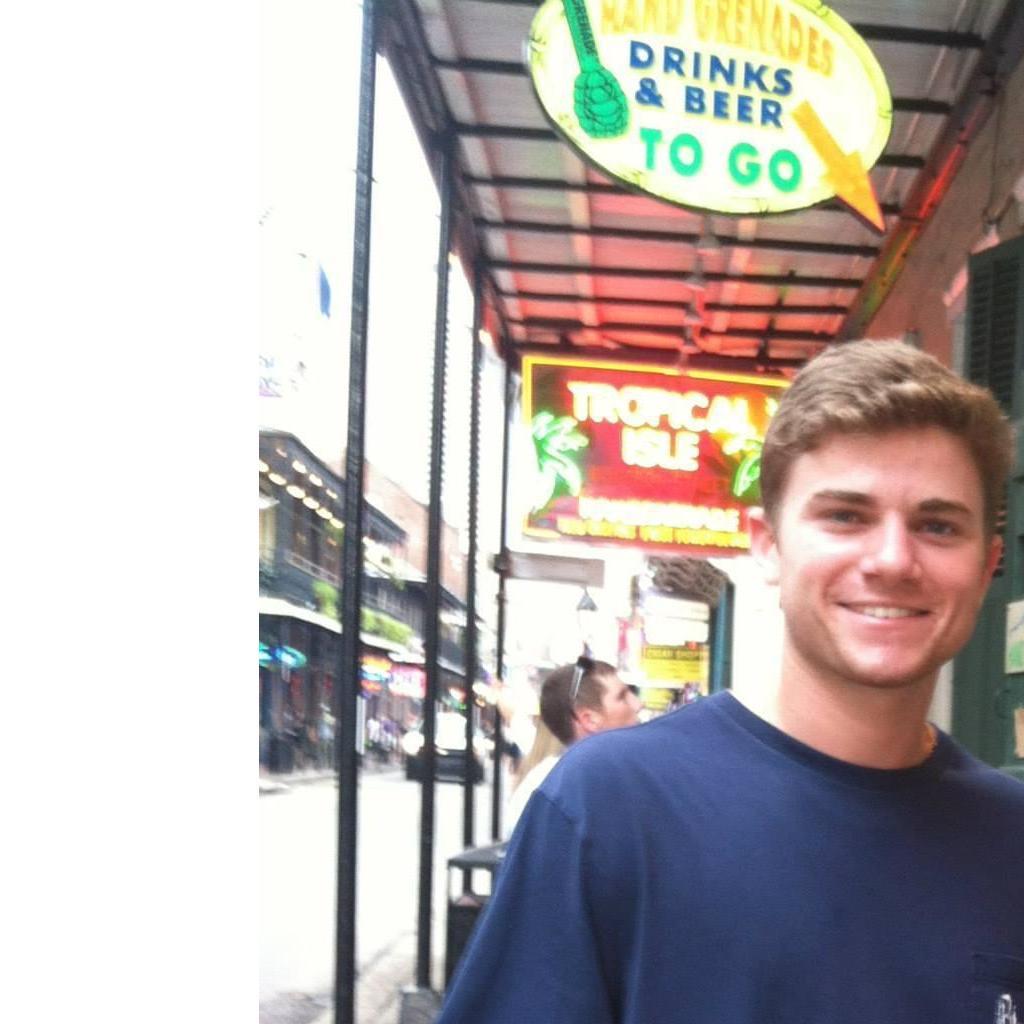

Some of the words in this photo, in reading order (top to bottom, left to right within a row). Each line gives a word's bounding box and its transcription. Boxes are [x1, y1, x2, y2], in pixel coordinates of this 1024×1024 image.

[600, 0, 683, 35] HAND
[693, 0, 835, 77] GRENADES
[629, 40, 793, 96] DRINKS
[635, 77, 663, 108] &
[684, 85, 783, 128] BEER
[640, 127, 703, 176] TO
[728, 142, 802, 192] GO
[566, 380, 757, 435] TROPICAL
[621, 425, 700, 471] ISLE
